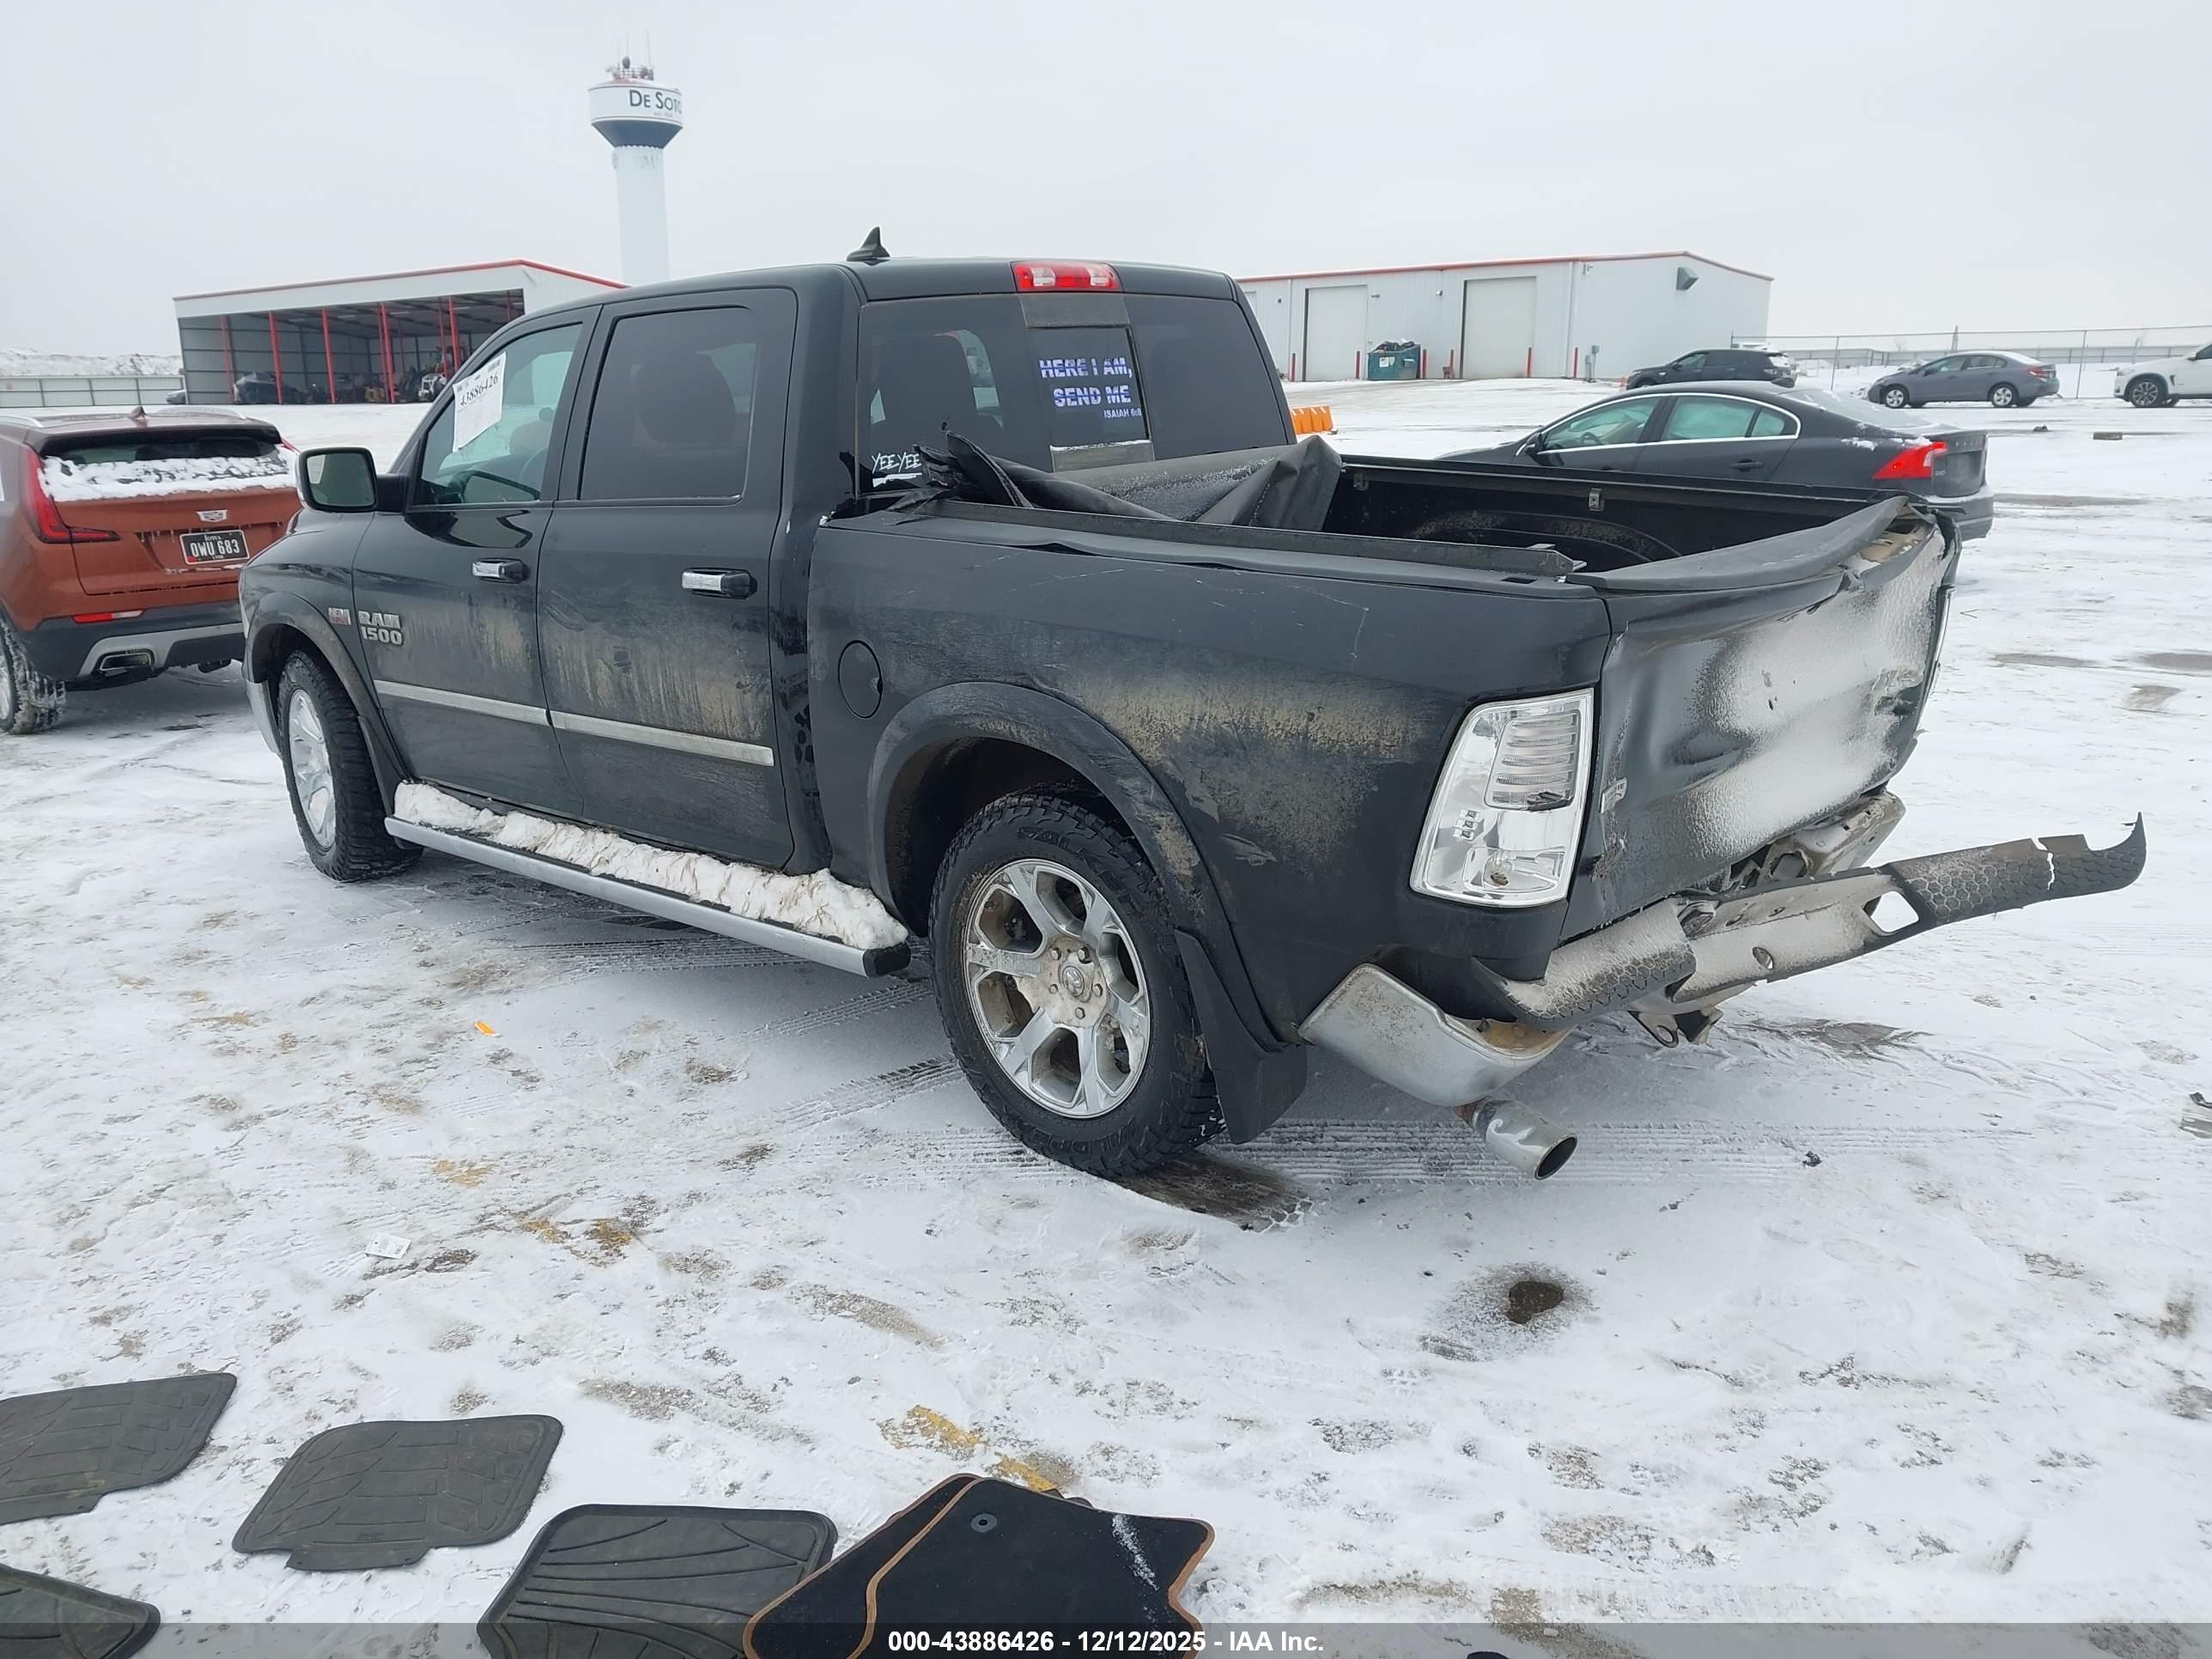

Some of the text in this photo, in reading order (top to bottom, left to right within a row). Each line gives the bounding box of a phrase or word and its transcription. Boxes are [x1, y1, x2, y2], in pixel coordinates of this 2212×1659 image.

[1039, 357, 1132, 378] HERE I AM,
[1054, 386, 1131, 406] SEND ME
[1103, 409, 1129, 418] ISAIAH
[217, 539, 240, 554] 683
[358, 611, 401, 629] RAM
[361, 626, 403, 645] 1500
